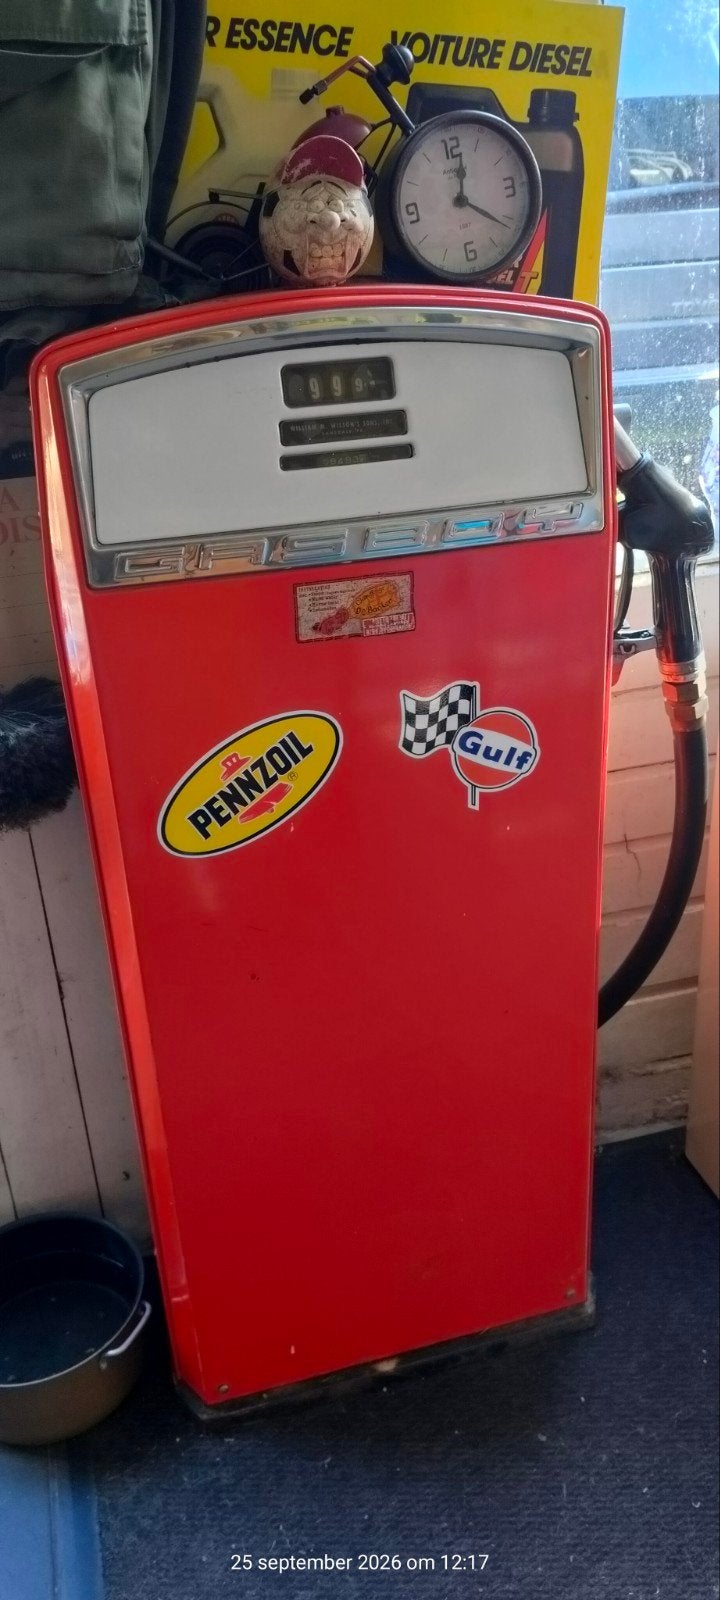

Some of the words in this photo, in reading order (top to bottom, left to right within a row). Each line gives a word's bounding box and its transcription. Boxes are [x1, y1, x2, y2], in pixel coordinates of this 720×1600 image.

[225, 17, 355, 58] ESSENCE
[508, 41, 592, 77] DIESEL
[441, 136, 462, 160] 12
[503, 176, 516, 198] 3
[405, 202, 420, 224] 9
[463, 240, 478, 262] 6
[114, 501, 584, 581] GASBOY
[458, 730, 533, 770] Gulf
[187, 731, 314, 840] PENNZOIL
